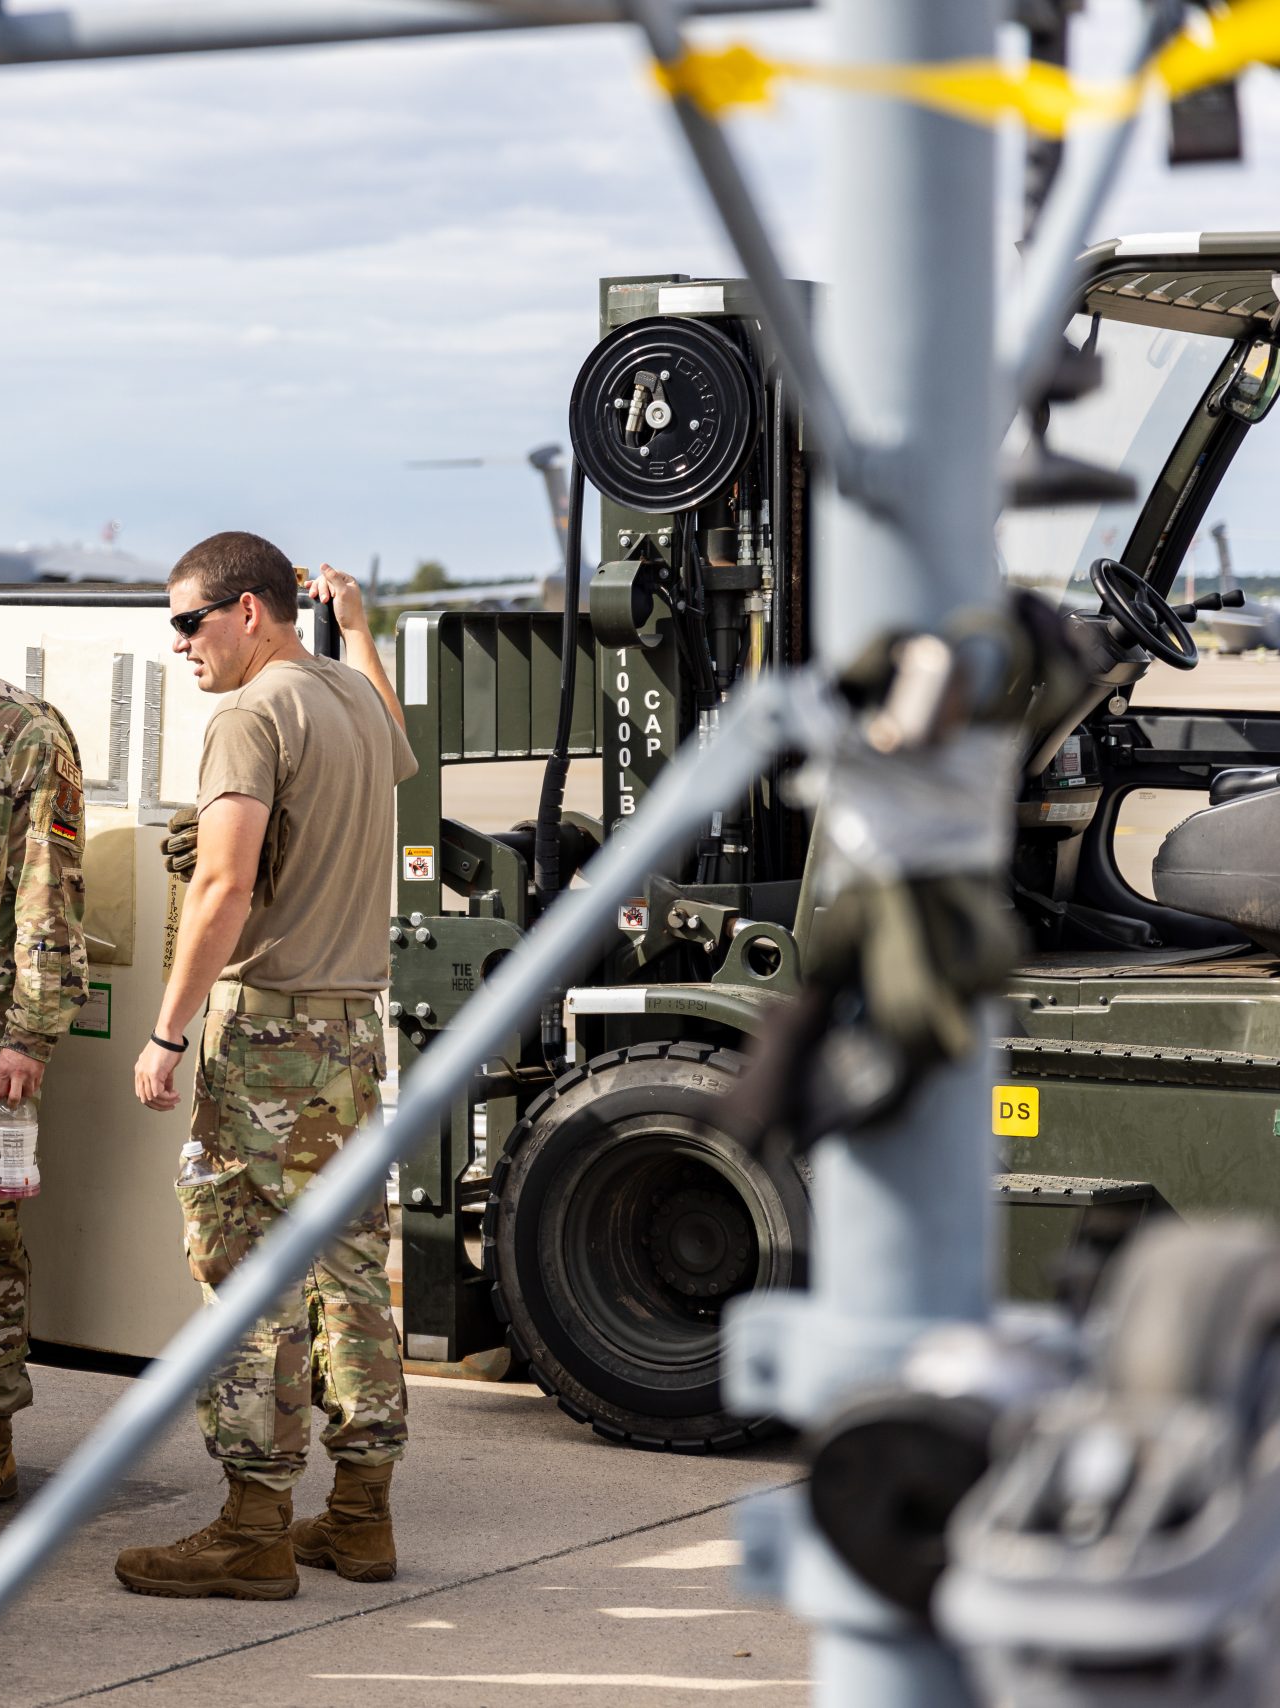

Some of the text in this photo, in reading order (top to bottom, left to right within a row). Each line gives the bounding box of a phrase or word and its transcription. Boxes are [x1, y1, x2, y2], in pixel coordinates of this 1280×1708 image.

[644, 690, 662, 757] CAP
[61, 759, 79, 785] AFE
[452, 963, 472, 976] TIE
[452, 978, 475, 991] HERE
[688, 1000, 708, 1012] PSI
[999, 1101, 1031, 1120] DS
